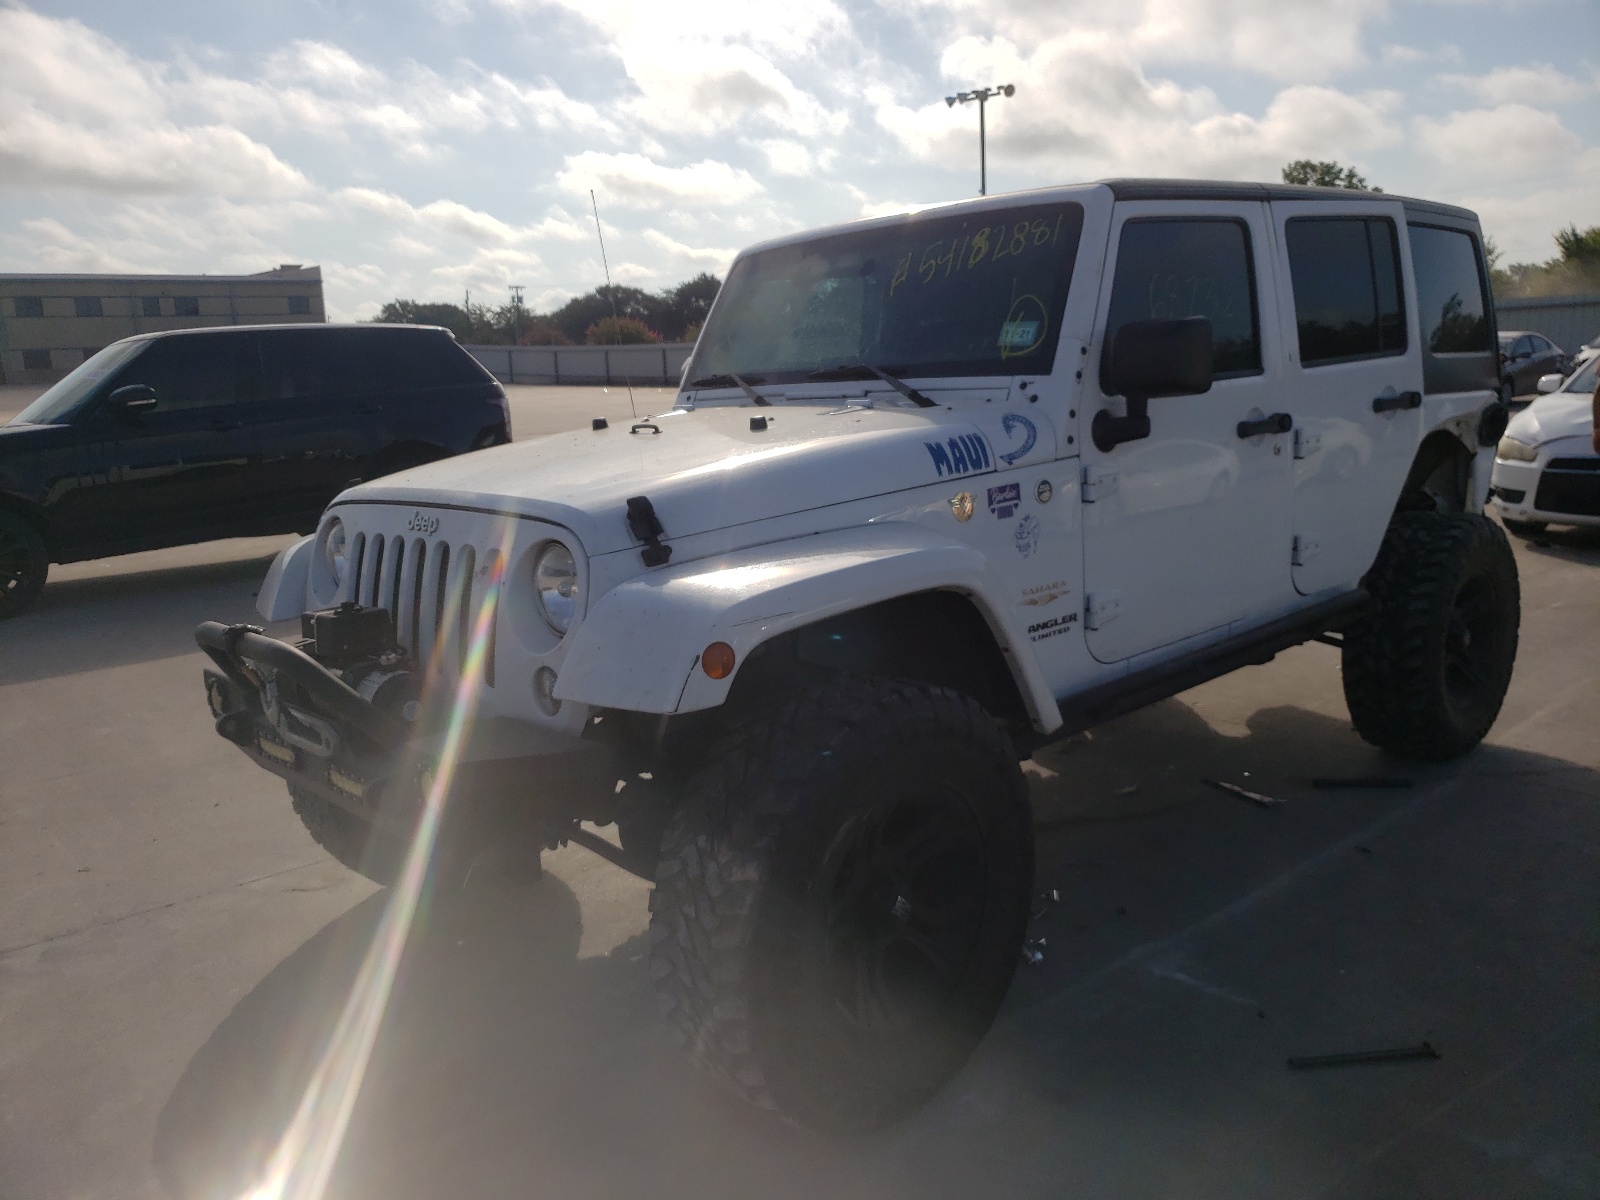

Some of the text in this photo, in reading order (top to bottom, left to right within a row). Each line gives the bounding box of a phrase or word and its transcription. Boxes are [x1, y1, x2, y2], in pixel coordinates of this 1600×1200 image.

[924, 432, 991, 477] MAUI
[407, 509, 440, 537] Jeep
[1021, 580, 1067, 596] SAHARA
[1028, 612, 1078, 634] ANGLER
